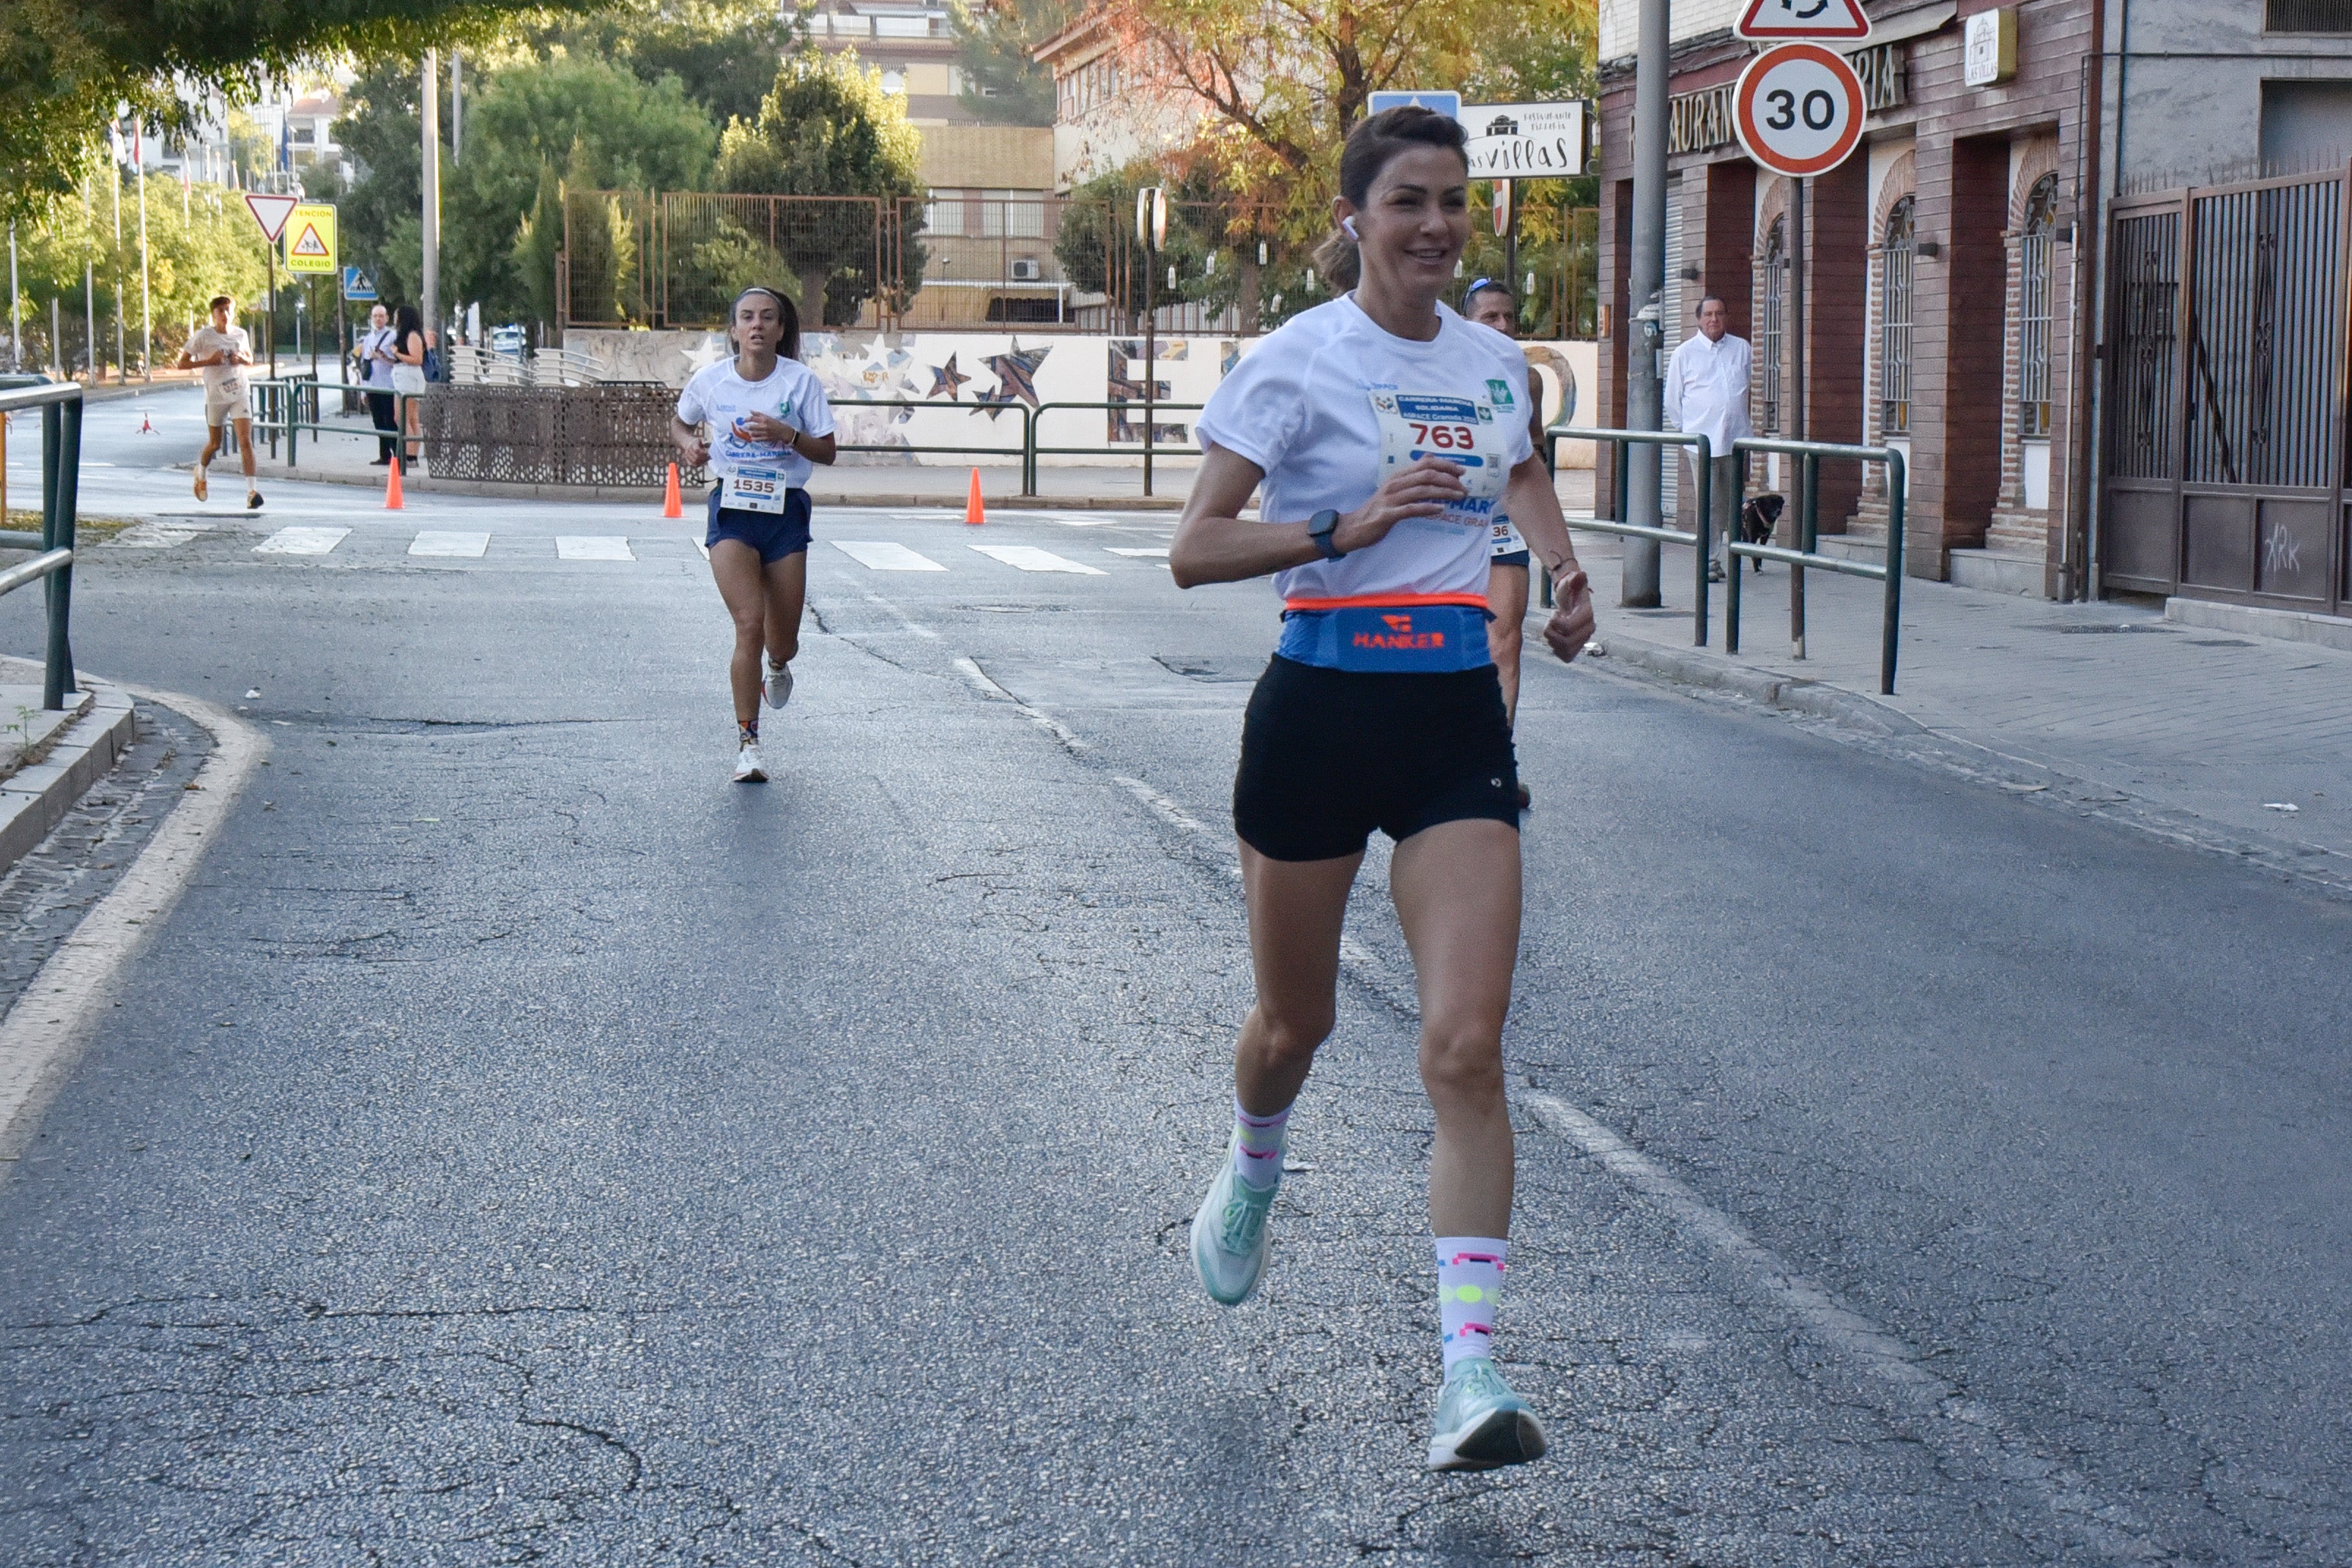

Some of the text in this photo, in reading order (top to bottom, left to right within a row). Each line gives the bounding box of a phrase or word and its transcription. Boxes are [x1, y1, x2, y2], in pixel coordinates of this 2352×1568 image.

[1766, 89, 1835, 130] 30
[291, 259, 331, 267] COLEGIO
[1409, 423, 1474, 450] 763
[733, 479, 775, 494] 1535
[1493, 526, 1509, 537] 36
